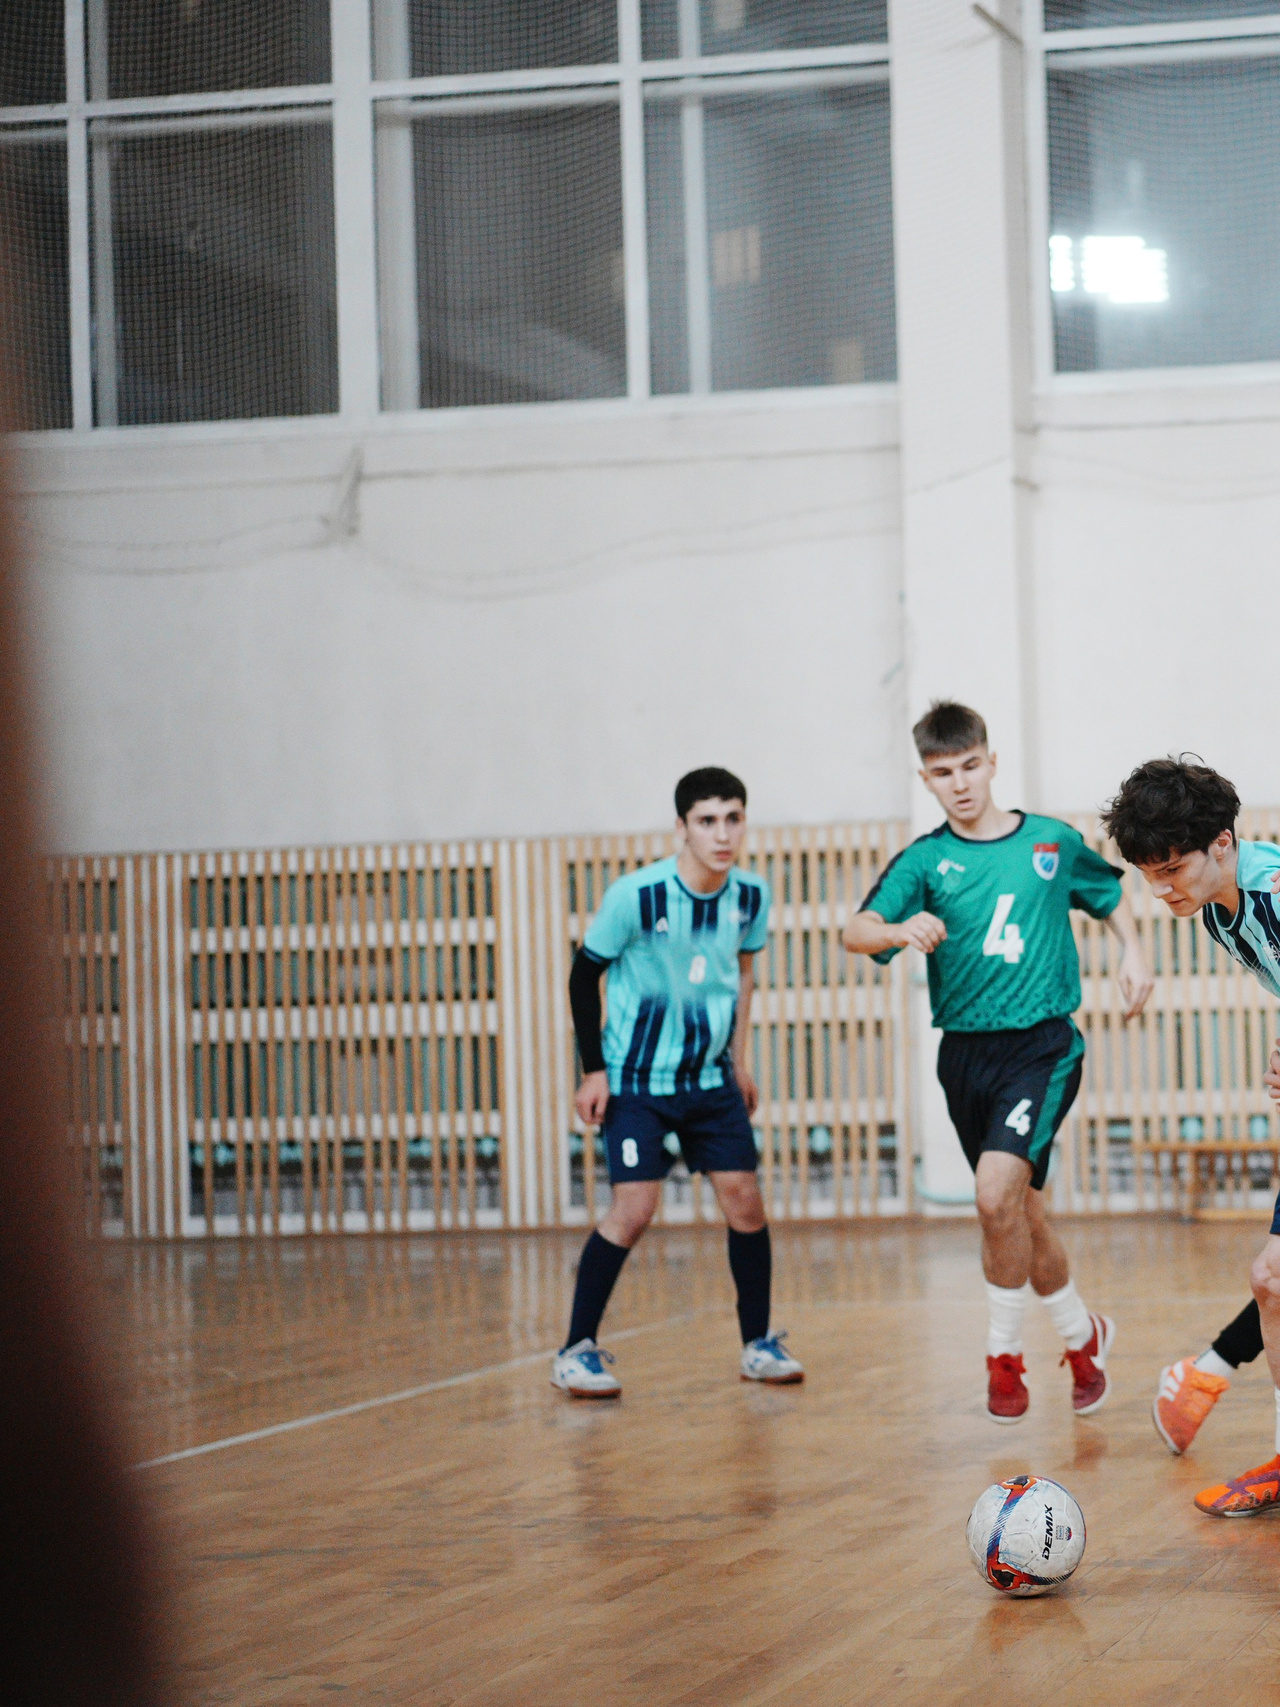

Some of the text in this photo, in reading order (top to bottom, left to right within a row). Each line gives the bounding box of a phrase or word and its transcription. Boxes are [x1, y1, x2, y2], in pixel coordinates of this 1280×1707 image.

[983, 893, 1025, 963] 4
[1005, 1098, 1033, 1137] 4
[621, 1138, 639, 1168] 8
[1042, 1504, 1053, 1560] DEMIX
